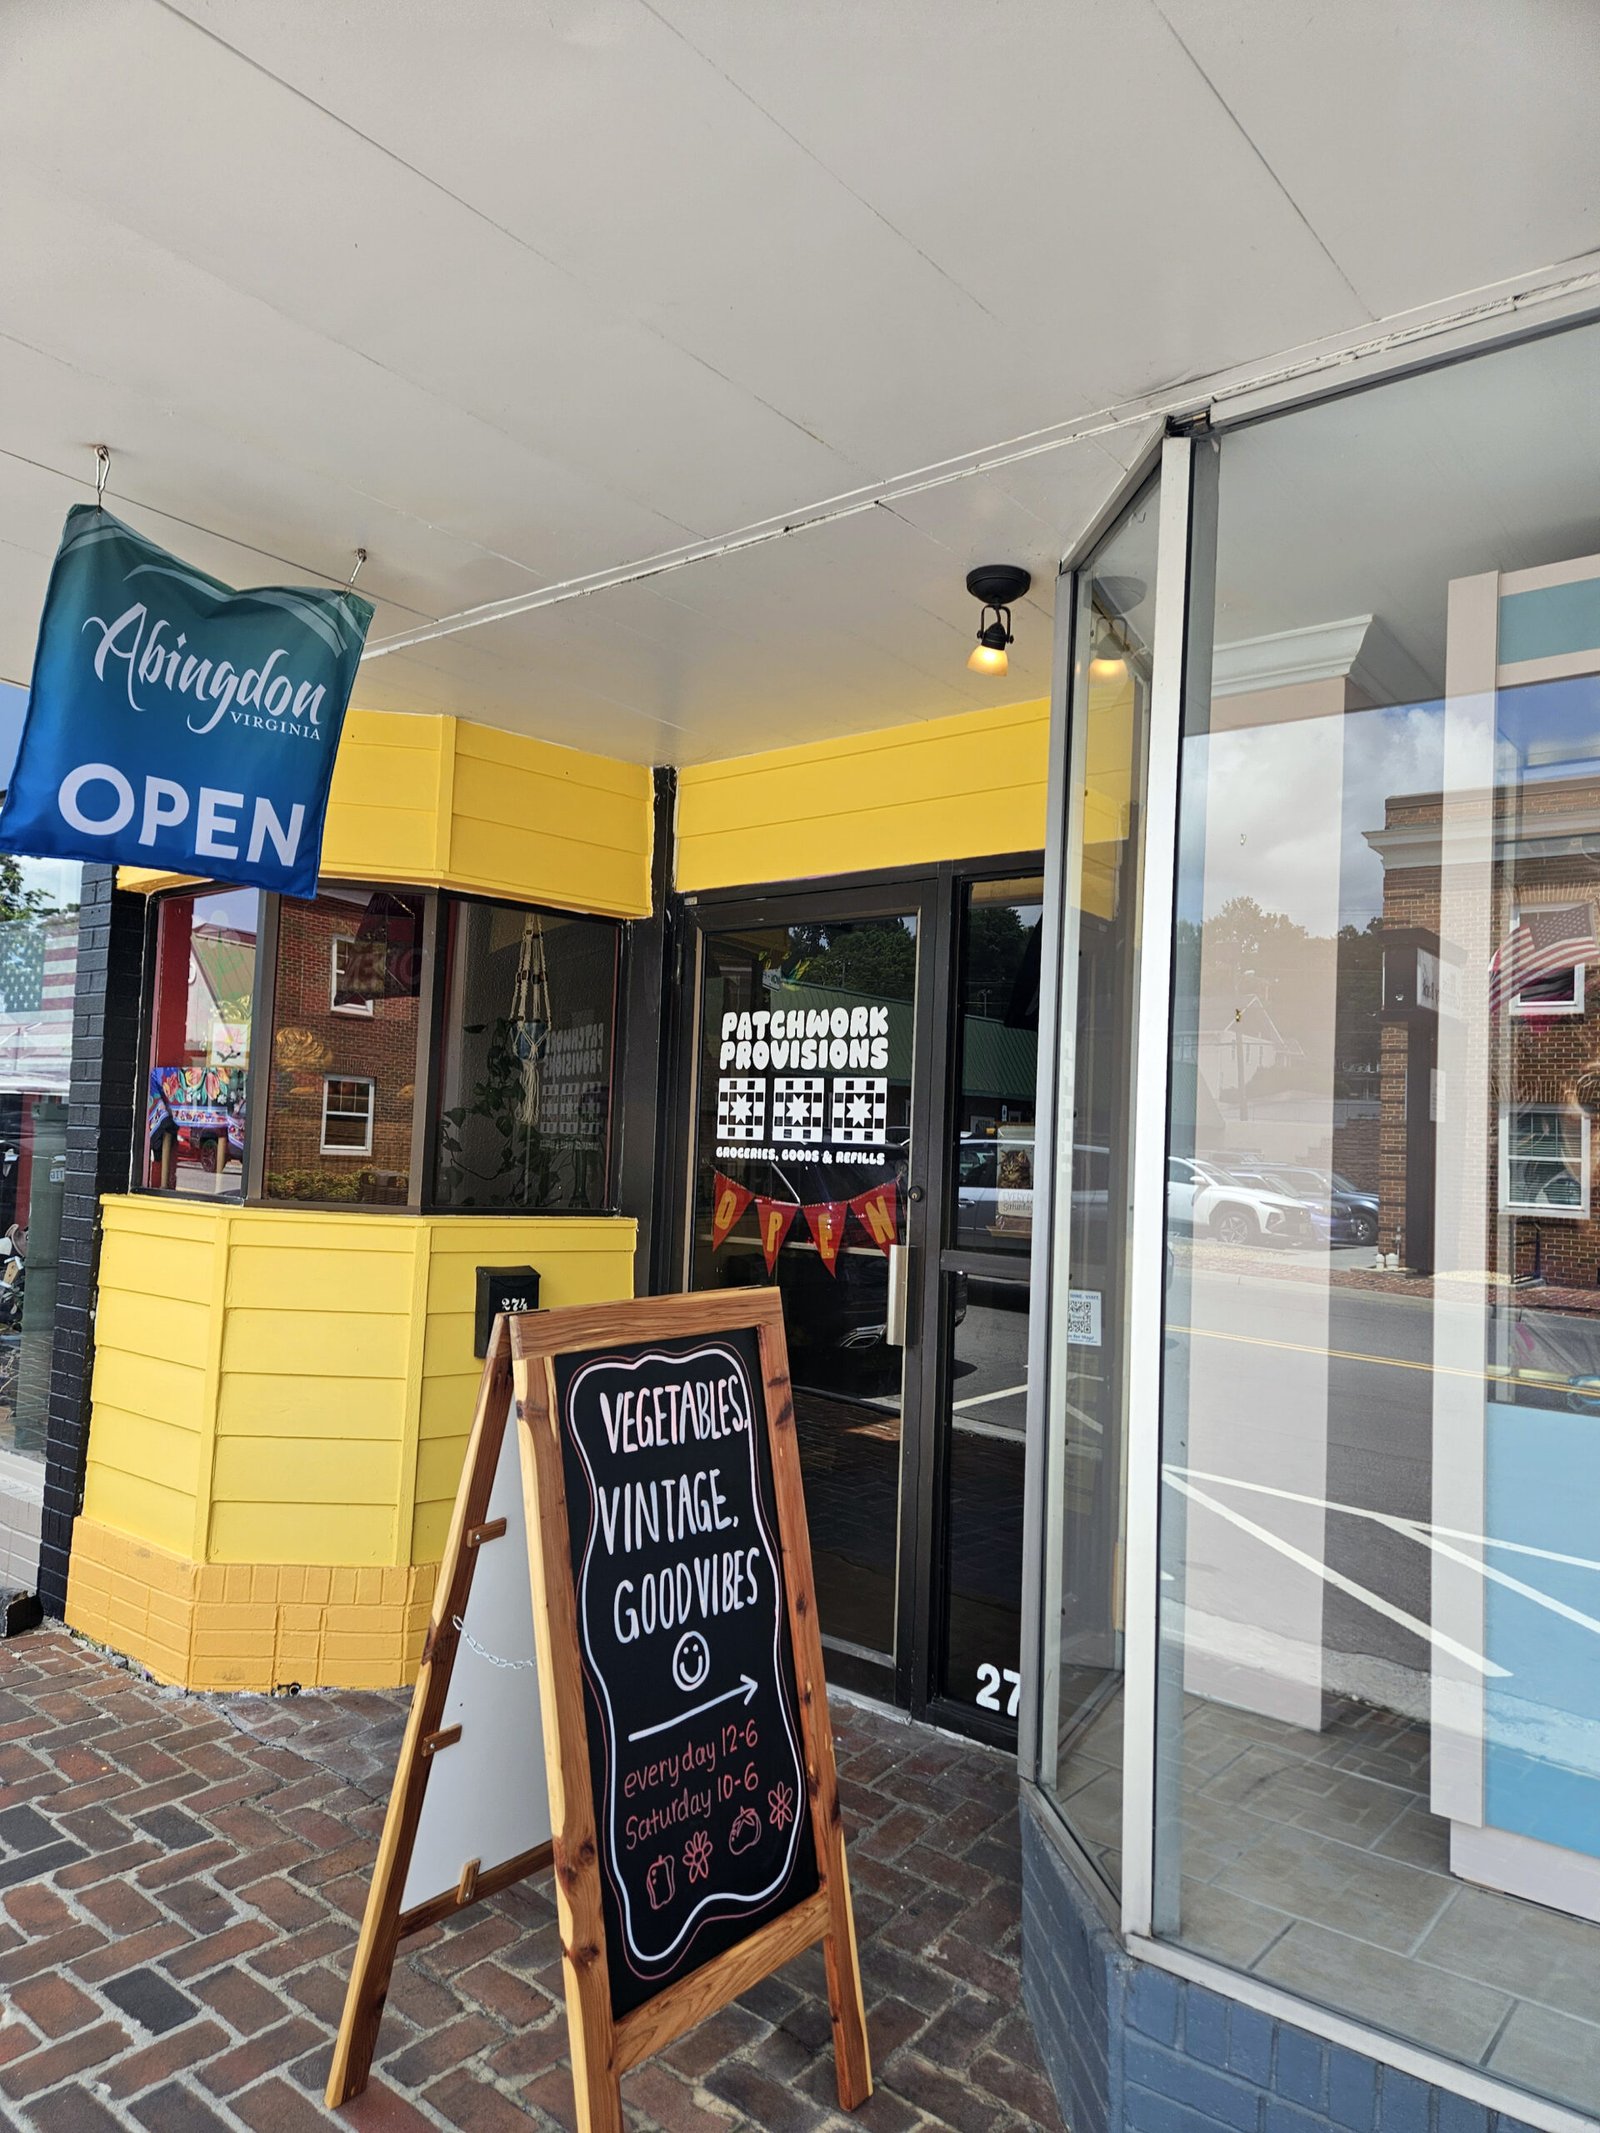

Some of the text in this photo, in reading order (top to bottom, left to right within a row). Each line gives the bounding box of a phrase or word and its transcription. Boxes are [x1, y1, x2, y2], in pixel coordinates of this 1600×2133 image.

[82, 602, 326, 734] Abingdon
[230, 711, 321, 740] VIRGINIA
[58, 763, 305, 867] OPEN
[722, 1006, 889, 1041] PATCHWORK
[719, 1037, 889, 1070] PROVISIONS
[716, 1147, 886, 1166] GROCERIES, GOODS & REFILLS
[715, 1188, 895, 1259] OPEN
[501, 1298, 528, 1312] 274
[624, 1719, 758, 1798] everyday 12-6
[625, 1762, 759, 1849] Saturday 10-6
